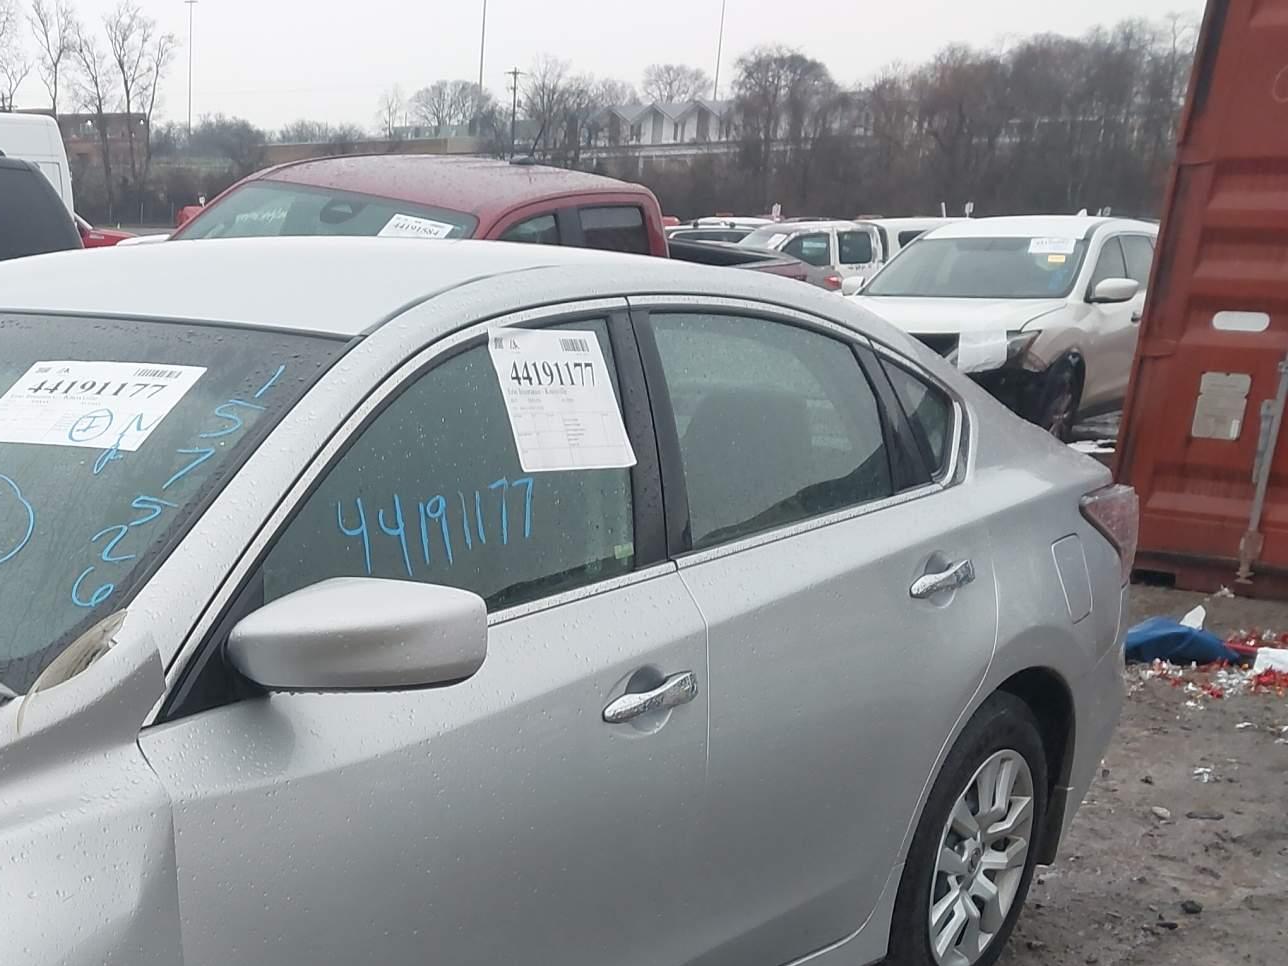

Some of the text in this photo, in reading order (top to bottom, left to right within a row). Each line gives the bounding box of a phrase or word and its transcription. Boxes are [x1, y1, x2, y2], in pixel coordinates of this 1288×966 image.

[509, 359, 596, 387] 44191177
[26, 379, 169, 399] 44191177
[337, 475, 535, 577] 44191177
